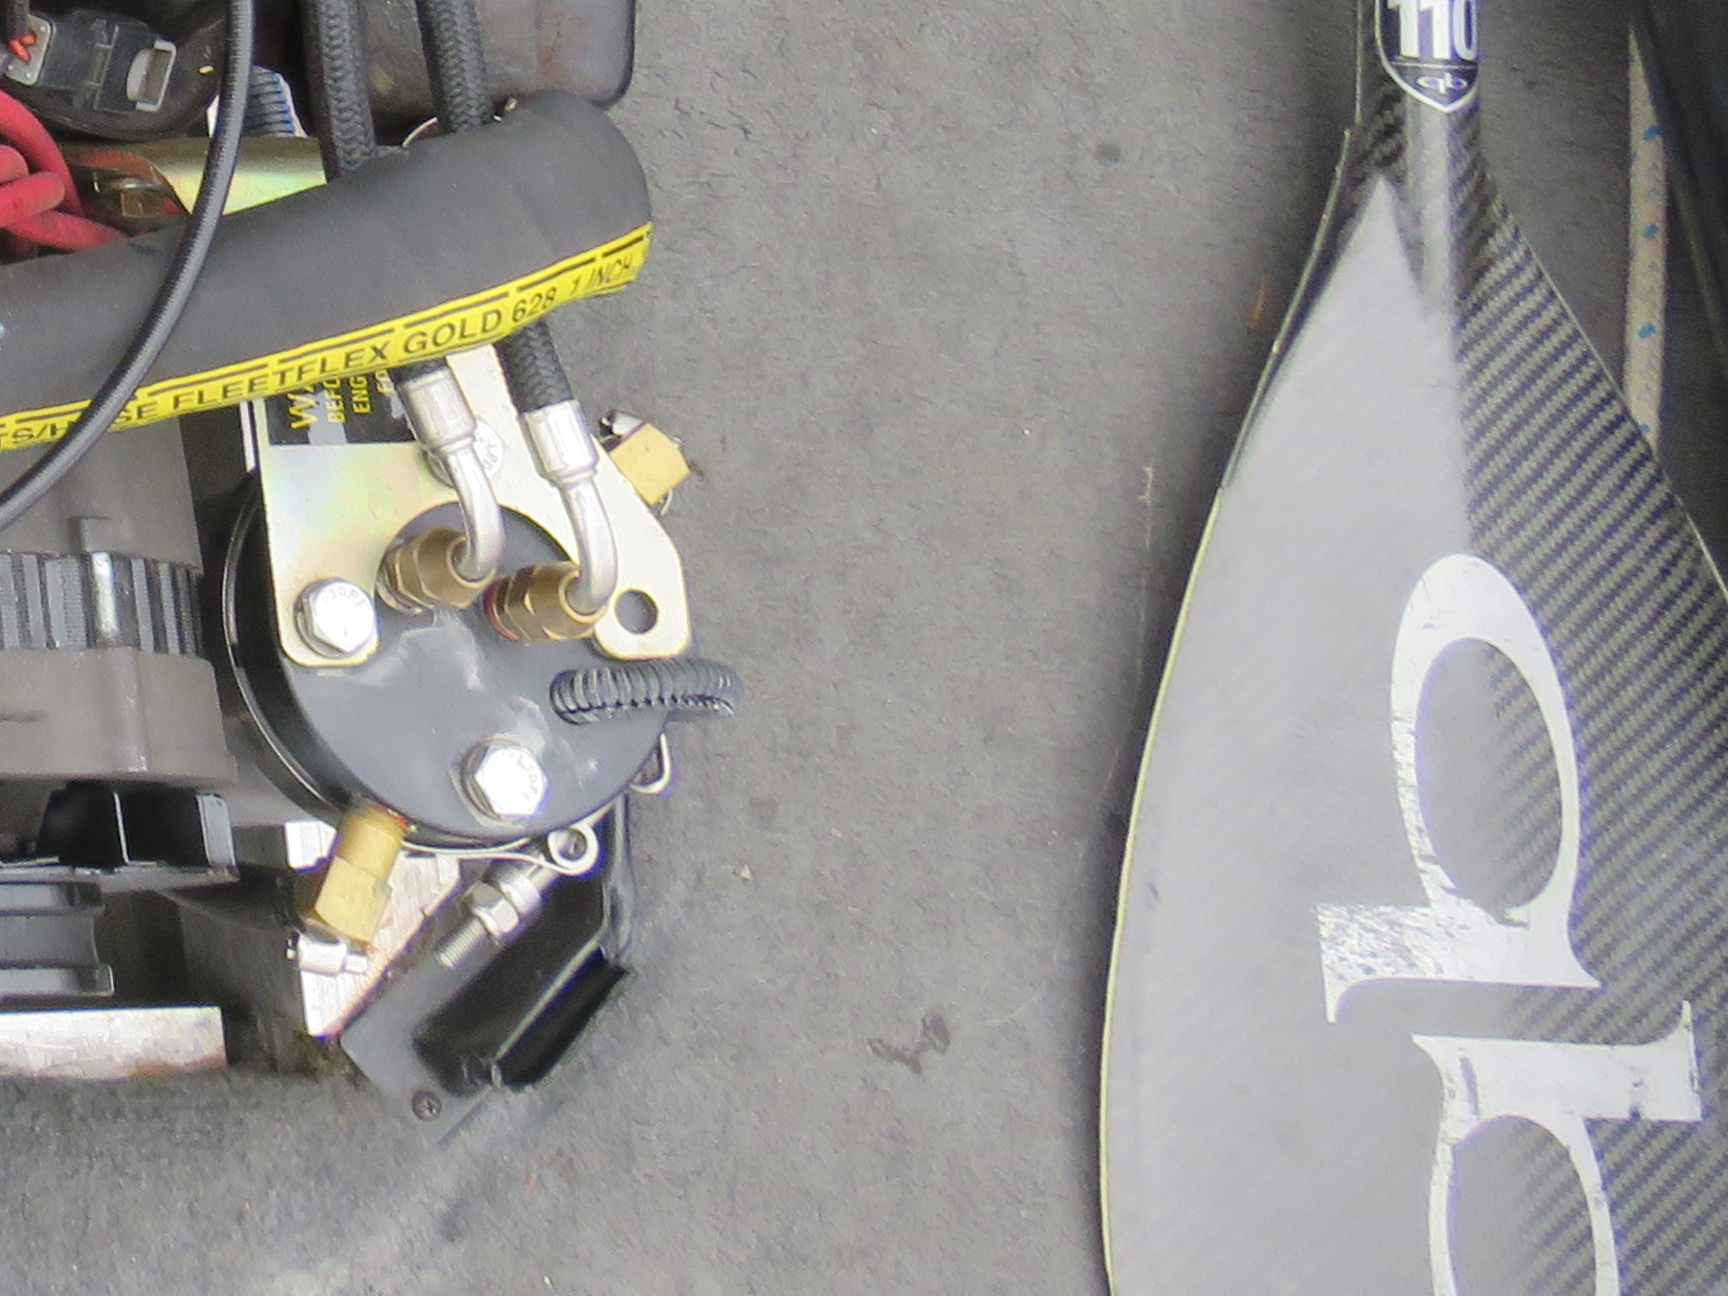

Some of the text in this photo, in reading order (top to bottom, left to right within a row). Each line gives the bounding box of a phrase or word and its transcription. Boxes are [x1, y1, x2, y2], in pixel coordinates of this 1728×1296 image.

[171, 340, 389, 410] FLEETFLEX
[402, 309, 503, 355] GOLD
[510, 285, 558, 324] 628
[570, 275, 583, 299] 1
[587, 253, 635, 291] INCH
